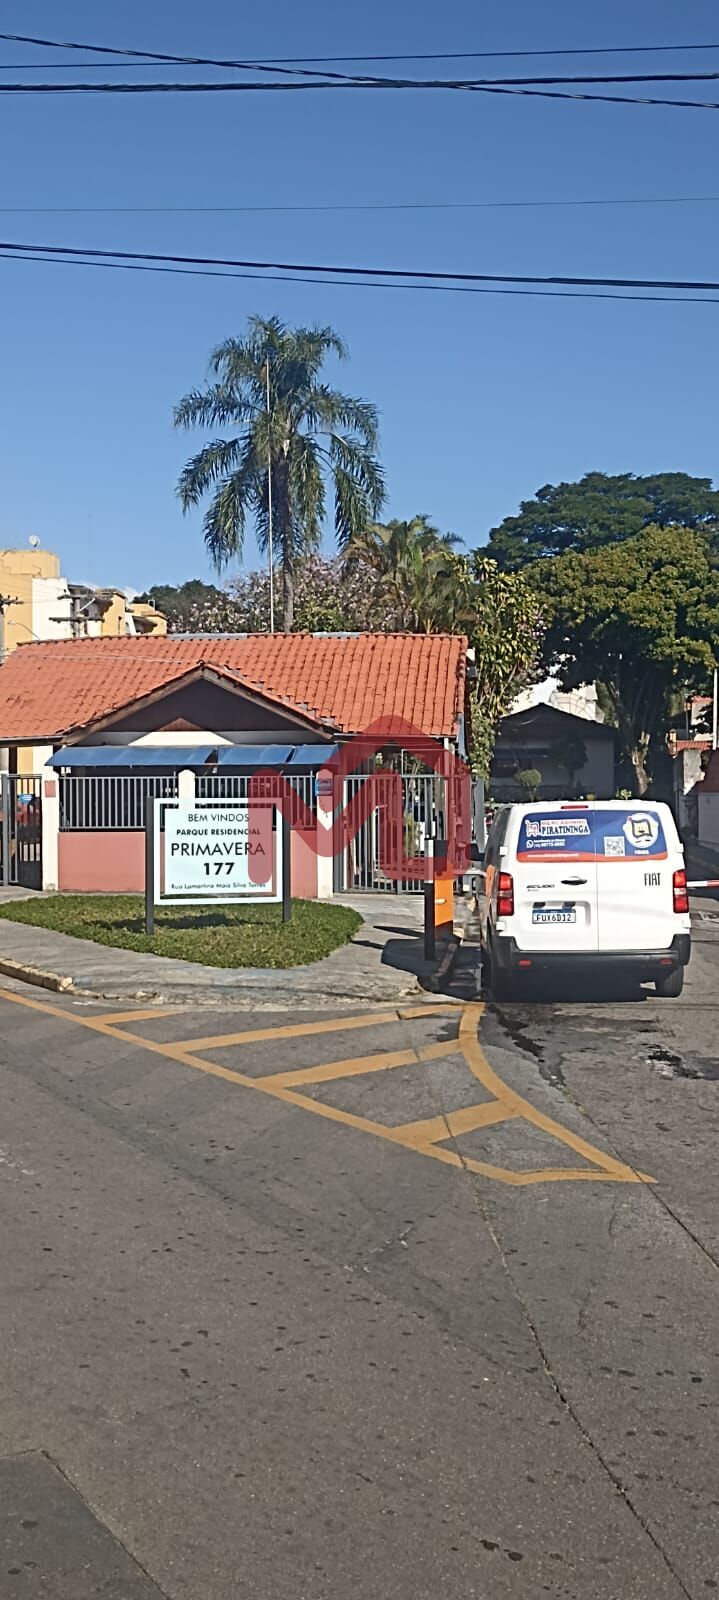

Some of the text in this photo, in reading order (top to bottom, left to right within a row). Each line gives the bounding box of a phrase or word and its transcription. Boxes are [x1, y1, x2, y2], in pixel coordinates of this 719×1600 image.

[188, 813, 249, 822] BEM VINDOS
[176, 828, 261, 836] PARQUE RESIDENCIAL
[541, 825, 589, 834] PIRATININGA
[171, 842, 266, 856] PRIMAVERA
[203, 862, 235, 875] 177
[644, 872, 661, 886] FIAT
[536, 913, 572, 922] FUX6D12
